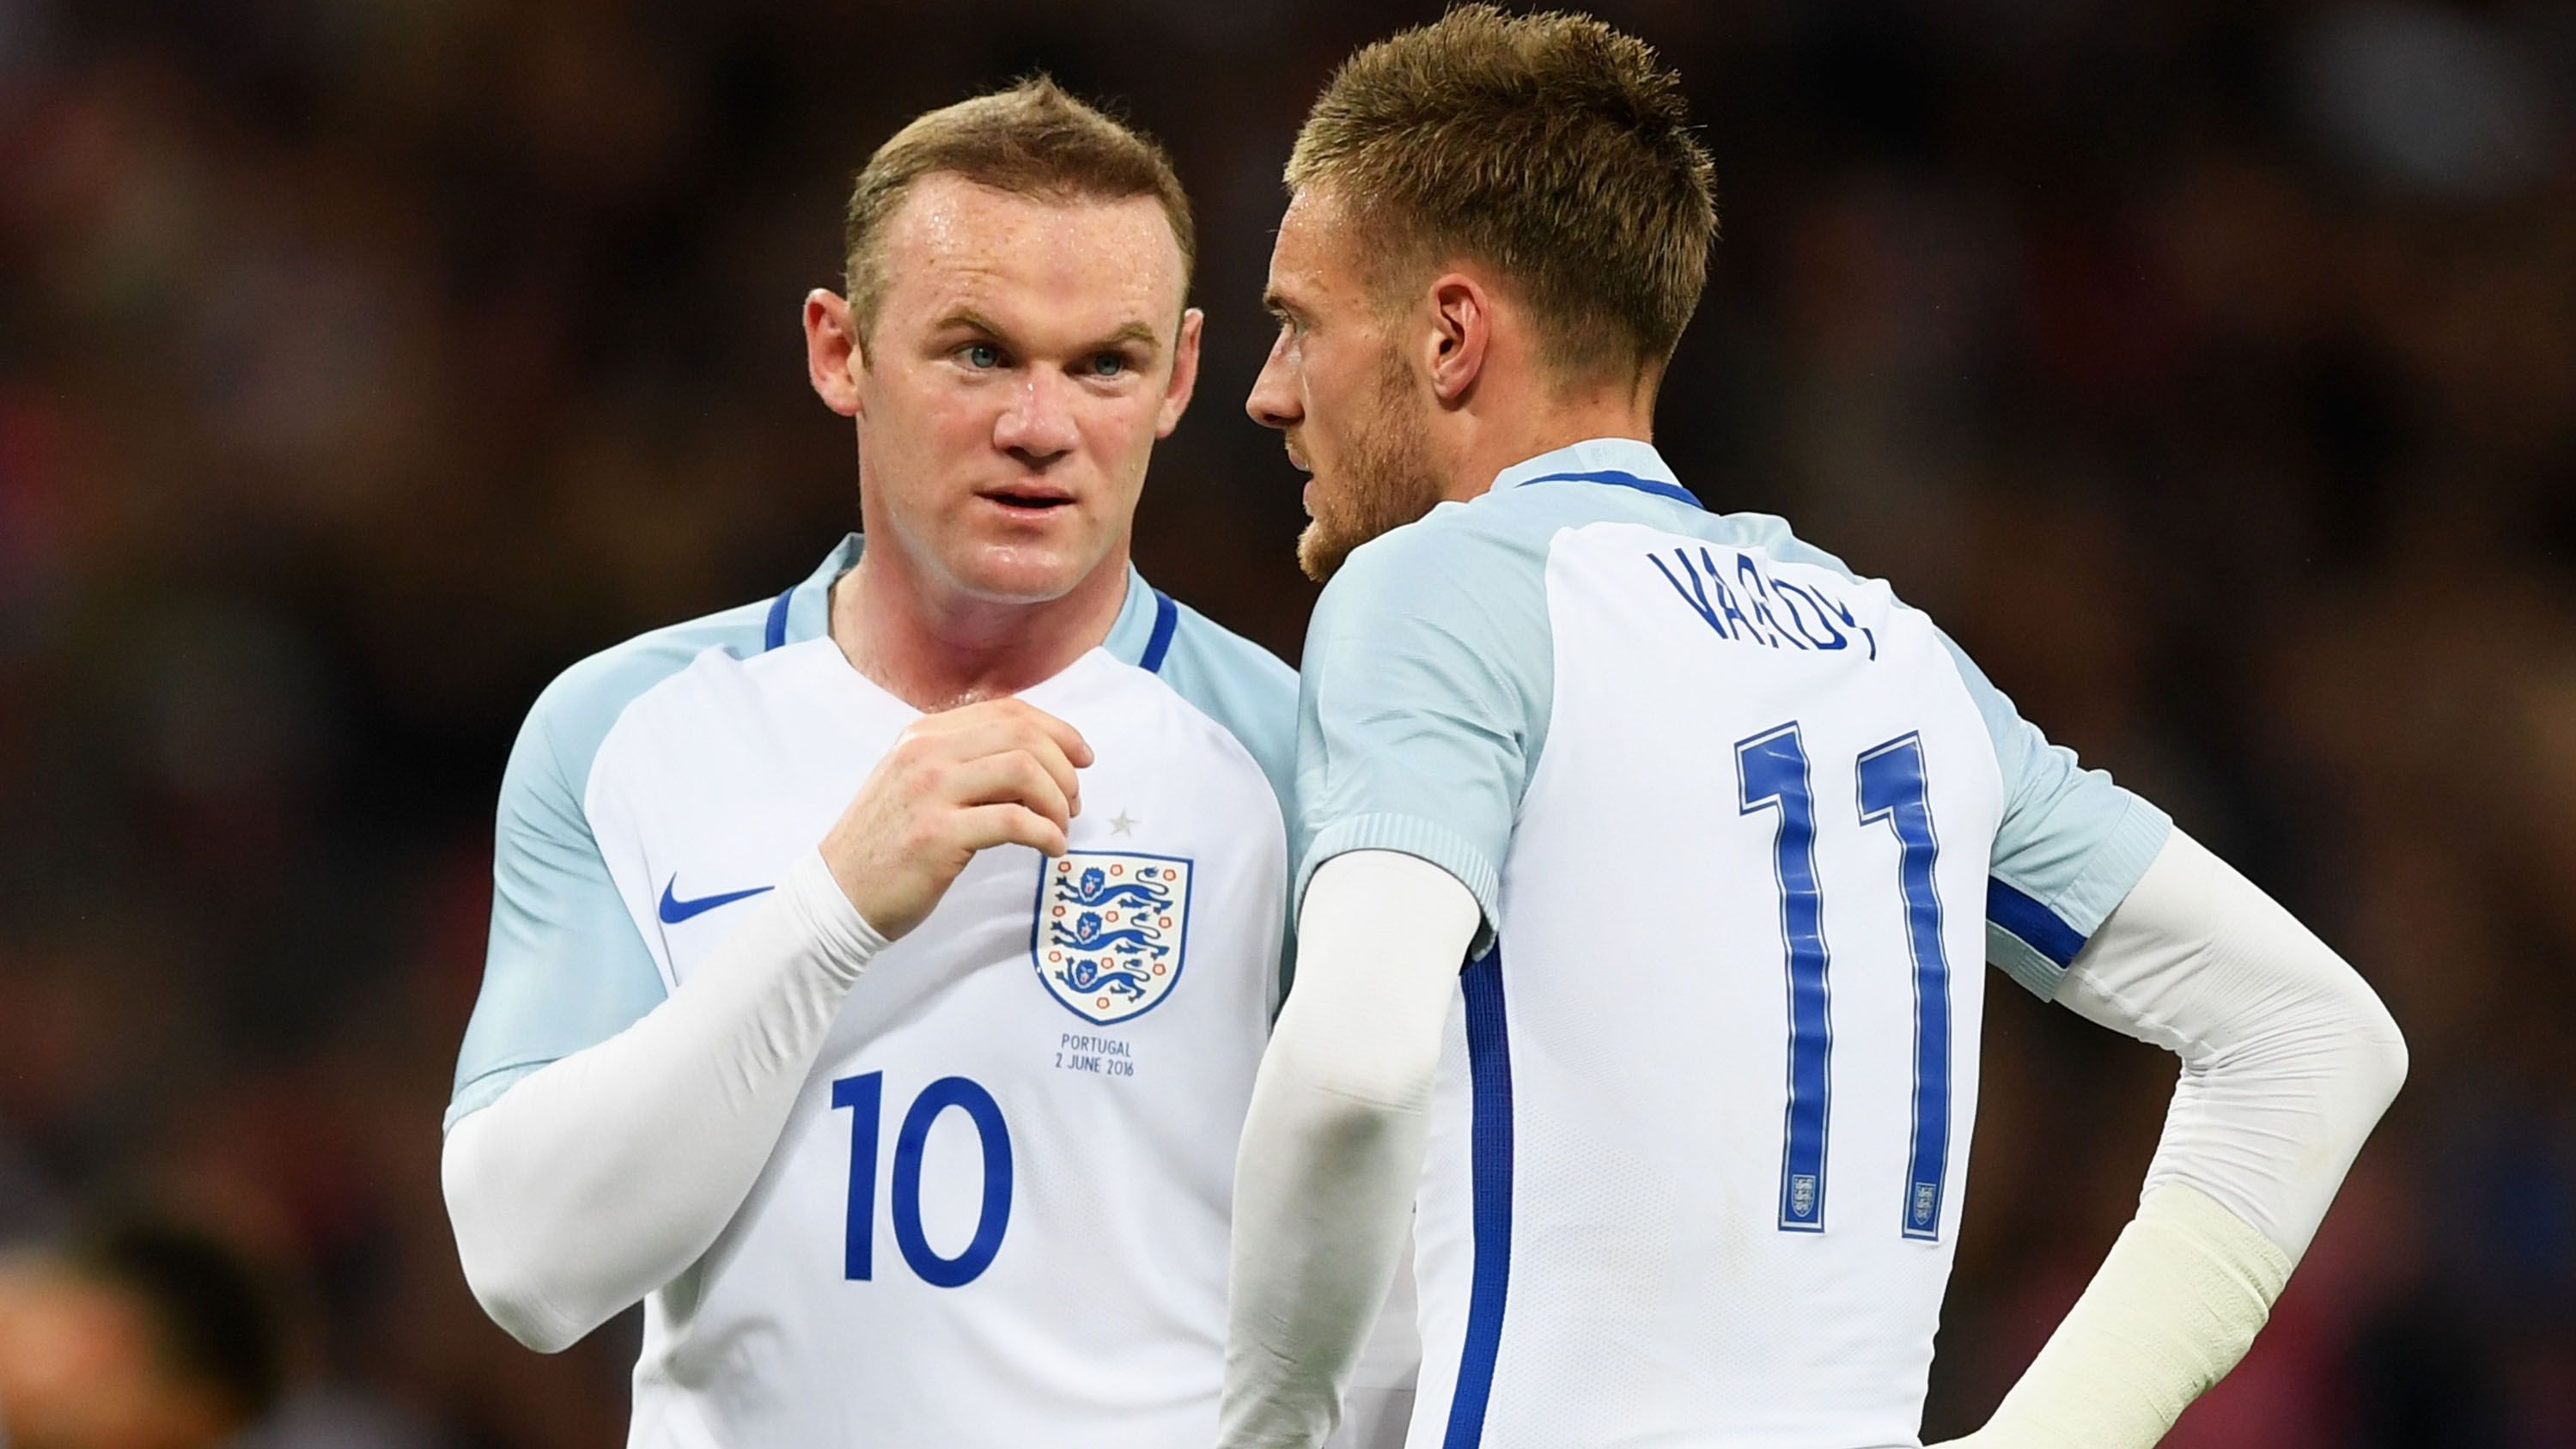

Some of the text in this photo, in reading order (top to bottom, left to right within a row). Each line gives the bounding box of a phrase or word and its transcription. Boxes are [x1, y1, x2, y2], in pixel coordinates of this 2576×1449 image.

[1647, 547, 1876, 661] VARDY
[1734, 720, 1951, 1242] 11
[1055, 1052, 1135, 1077] 2 JUNE 2016
[1061, 1033, 1131, 1058] PORTUGAL
[831, 1069, 1014, 1289] 10
